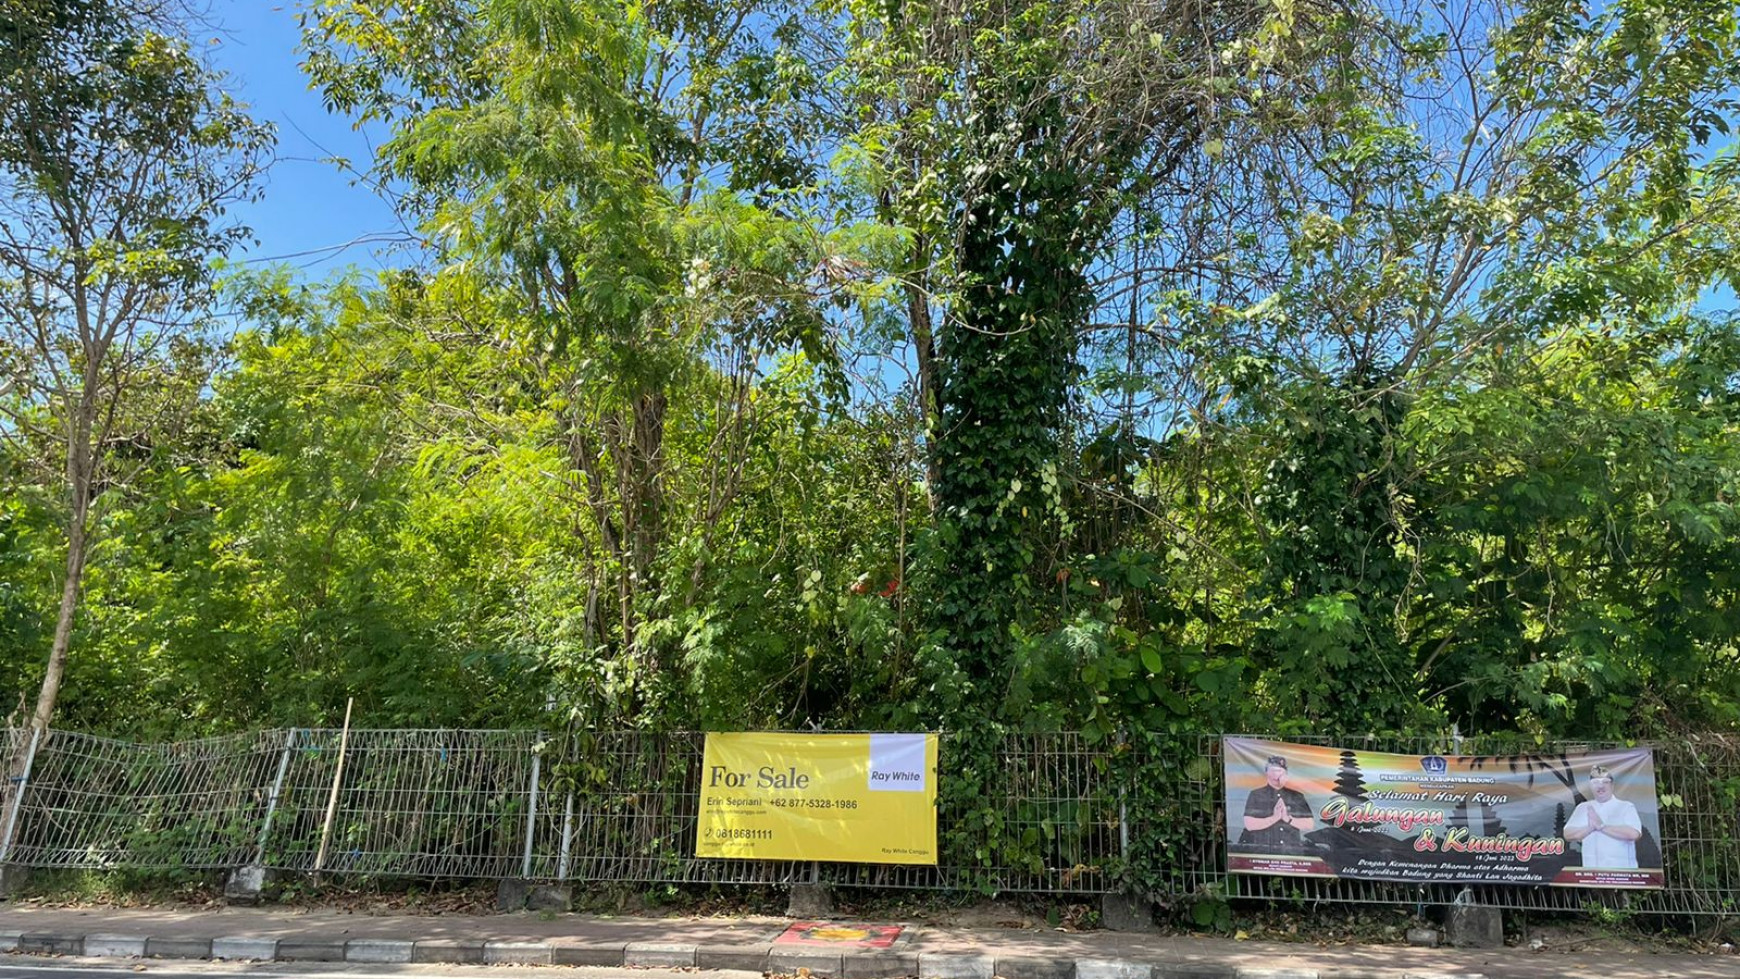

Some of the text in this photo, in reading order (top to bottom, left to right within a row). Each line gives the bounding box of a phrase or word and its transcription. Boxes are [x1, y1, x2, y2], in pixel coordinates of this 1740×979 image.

[709, 766, 809, 789] For Sale
[871, 771, 920, 782] Ray White
[707, 797, 858, 809] Erin Sepriani +62 877-5328-1986
[1369, 789, 1508, 806] Selamat Hari Raya
[1320, 795, 1445, 832] Galungan
[1414, 826, 1565, 862] & Kuningan
[1358, 859, 1387, 868] Dengan
[1389, 860, 1437, 869] Kemenangan
[1402, 869, 1432, 878] Badung
